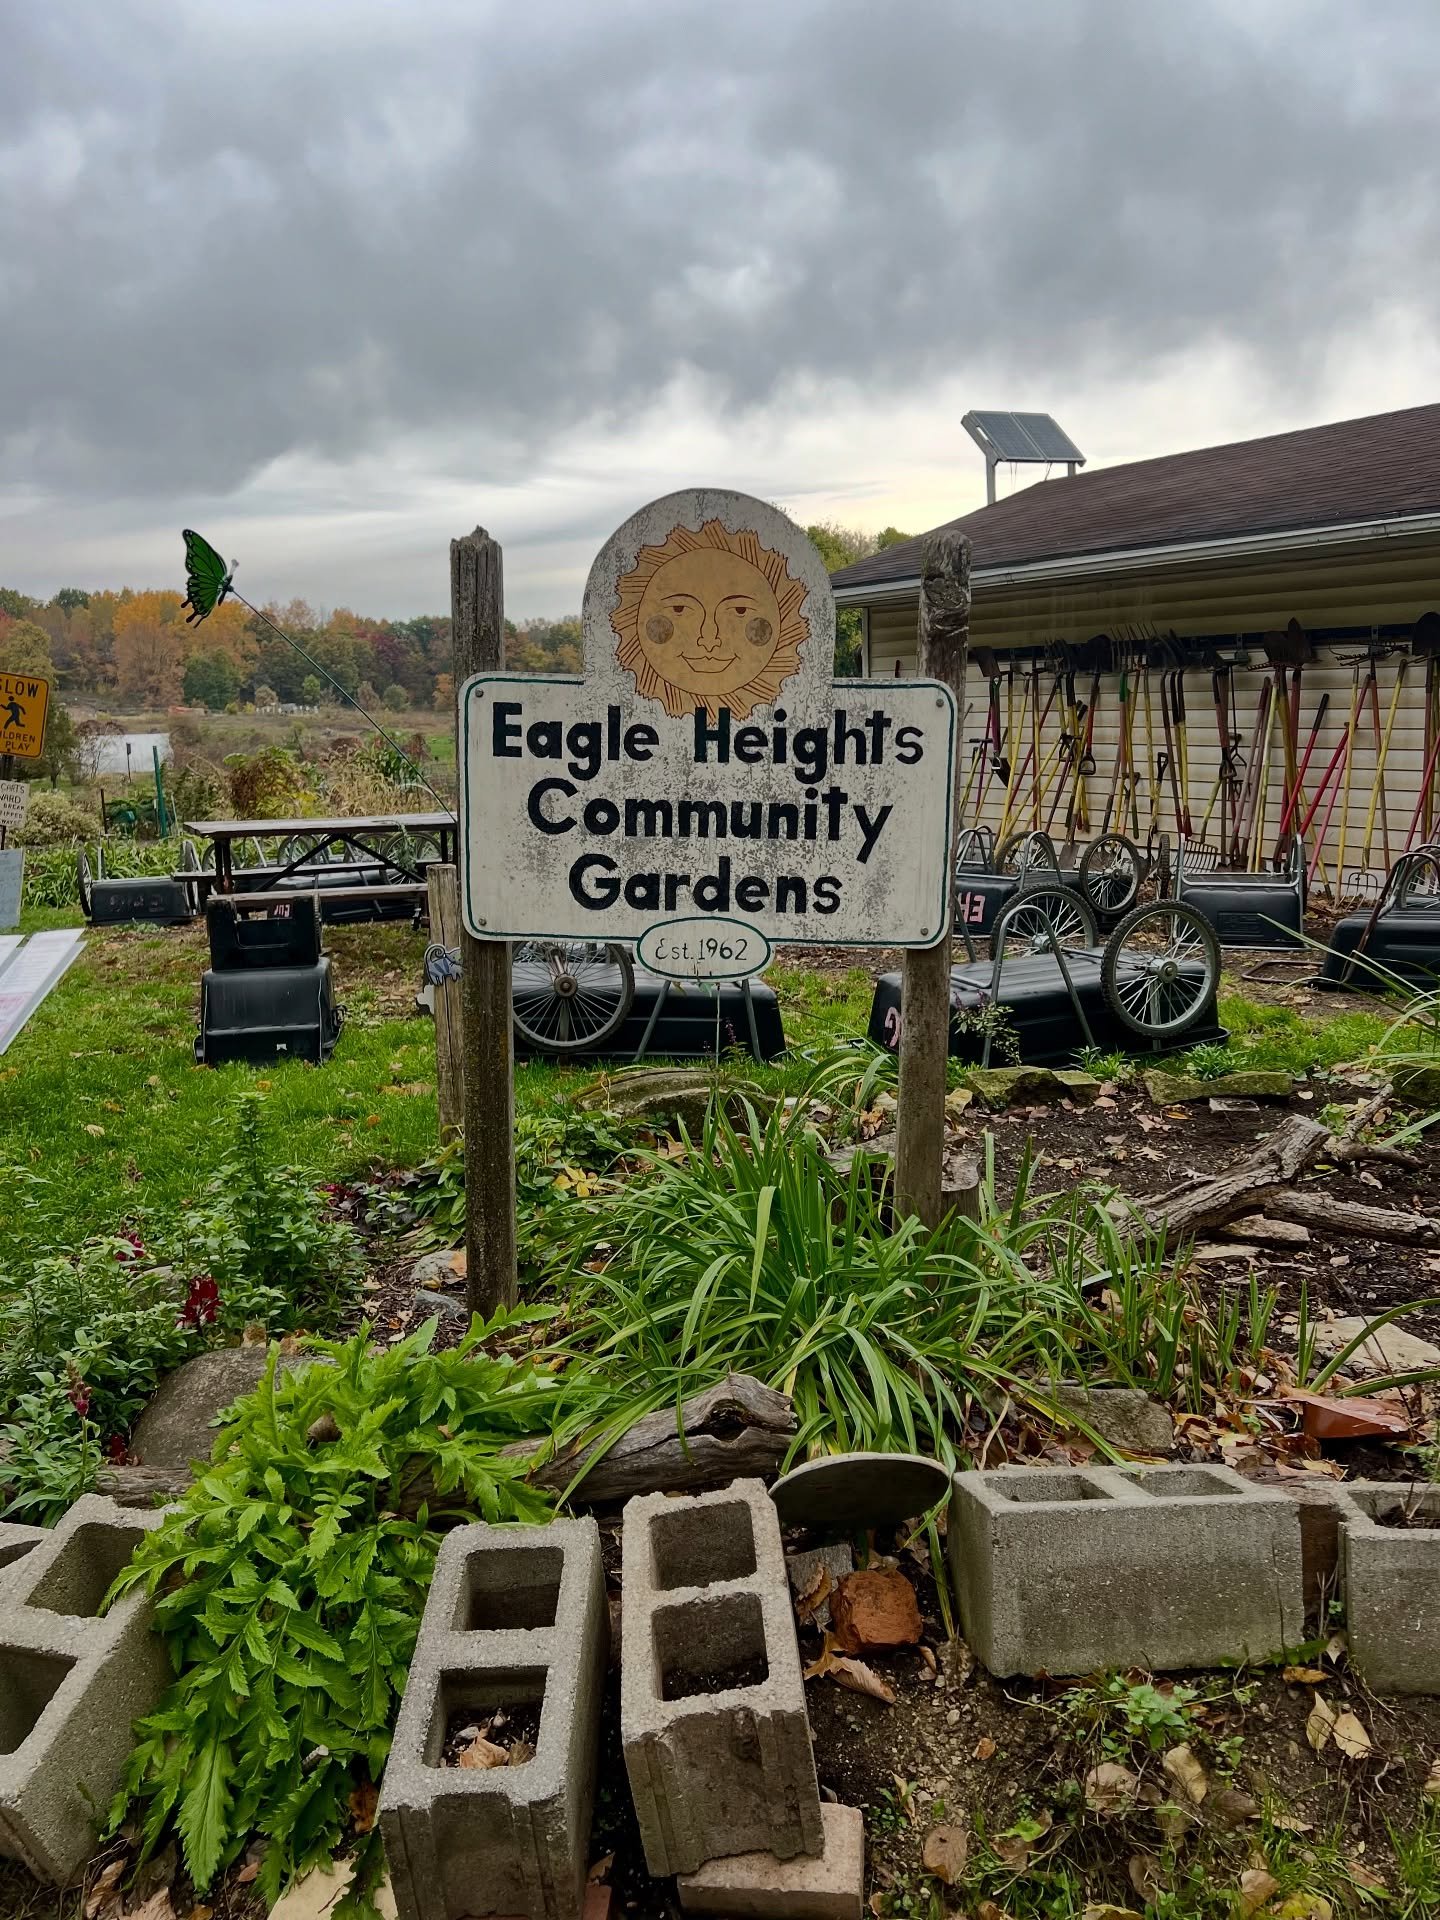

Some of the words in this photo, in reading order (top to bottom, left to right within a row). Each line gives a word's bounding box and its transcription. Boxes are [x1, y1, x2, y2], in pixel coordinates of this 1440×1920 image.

[5, 741, 30, 751] PLAY
[493, 702, 660, 780] Eagle
[694, 707, 924, 784] Heights
[527, 777, 893, 864] Community
[568, 853, 843, 914] Gardens
[698, 937, 748, 961] 1962
